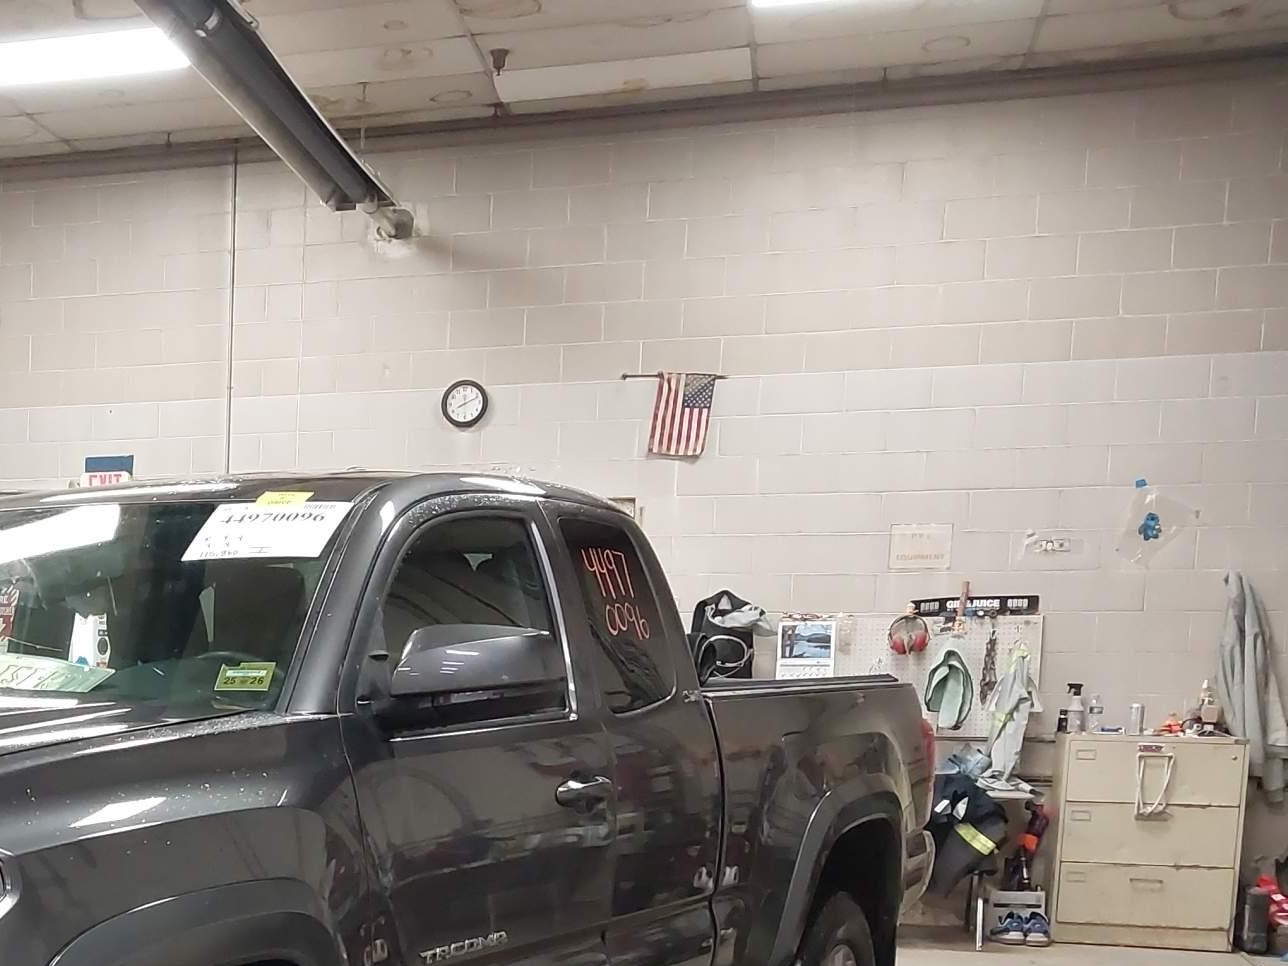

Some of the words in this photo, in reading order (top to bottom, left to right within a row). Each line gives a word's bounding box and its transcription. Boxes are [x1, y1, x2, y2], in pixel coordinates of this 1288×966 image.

[580, 547, 635, 600] 4497
[605, 602, 650, 641] 0096
[223, 676, 236, 685] 25
[249, 676, 265, 685] 26
[418, 931, 509, 965] TACOMA
